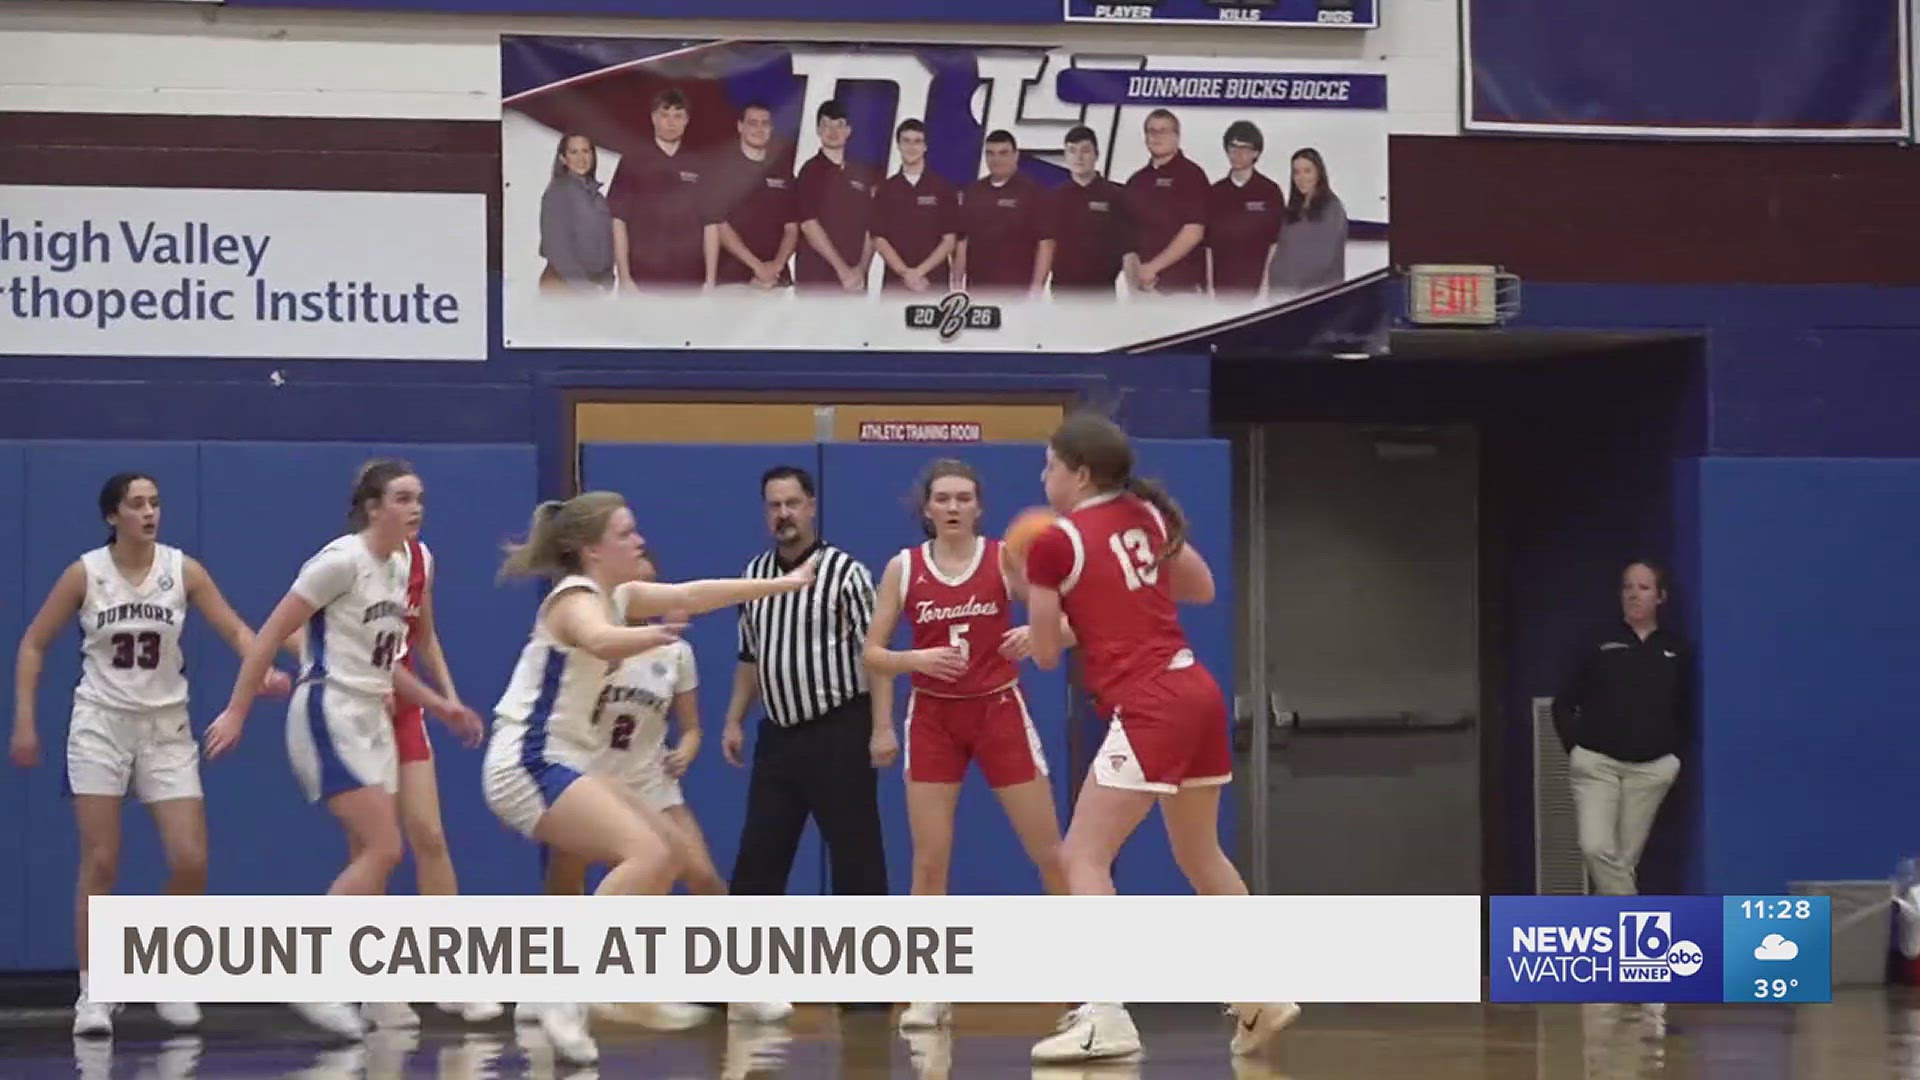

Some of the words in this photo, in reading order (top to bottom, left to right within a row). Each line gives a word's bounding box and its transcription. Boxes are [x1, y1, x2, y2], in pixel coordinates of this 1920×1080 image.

[1095, 5, 1153, 19] PLAYER
[1219, 8, 1261, 22] KILLS
[1317, 10, 1354, 23] DIGS
[1128, 76, 1223, 98] DUNMORE
[1225, 78, 1290, 100] BUCKS
[1290, 80, 1350, 101] BOCCE
[1, 218, 110, 272] high
[119, 220, 271, 277] Valley
[256, 278, 459, 324] Institute
[914, 308, 935, 325] 20
[971, 308, 992, 326] 26
[861, 423, 905, 440] ATHLETIC
[906, 423, 949, 440] TRAINING
[950, 423, 980, 440] ROOM
[1109, 528, 1158, 591] 13
[97, 603, 174, 629] DUNMORE
[916, 595, 998, 623] Tornadoes
[111, 631, 160, 670] 33
[949, 623, 970, 661] 5
[611, 714, 635, 751] 2
